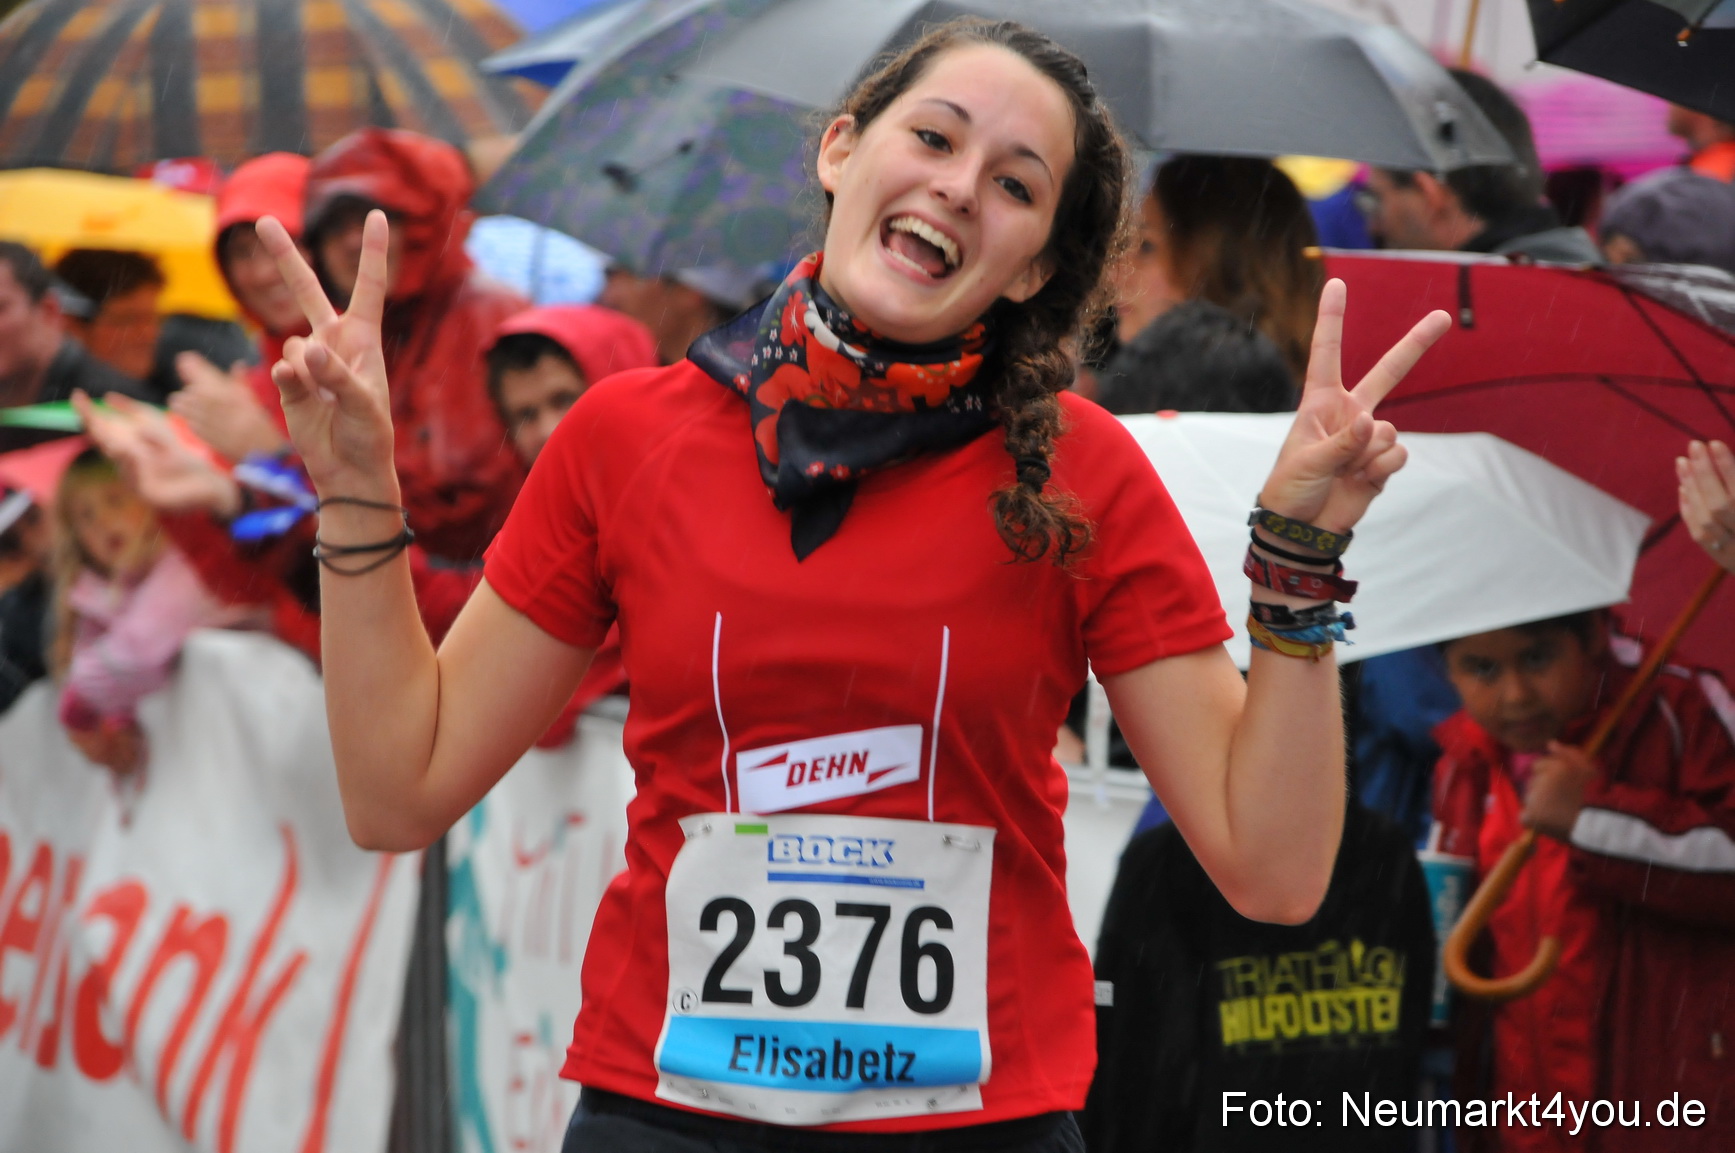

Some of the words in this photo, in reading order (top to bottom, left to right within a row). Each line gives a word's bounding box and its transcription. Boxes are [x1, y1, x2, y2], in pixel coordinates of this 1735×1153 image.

[785, 751, 869, 790] DEHN
[768, 834, 895, 868] BOCK
[699, 897, 955, 1015] 2376
[728, 1034, 917, 1084] Elisabetz
